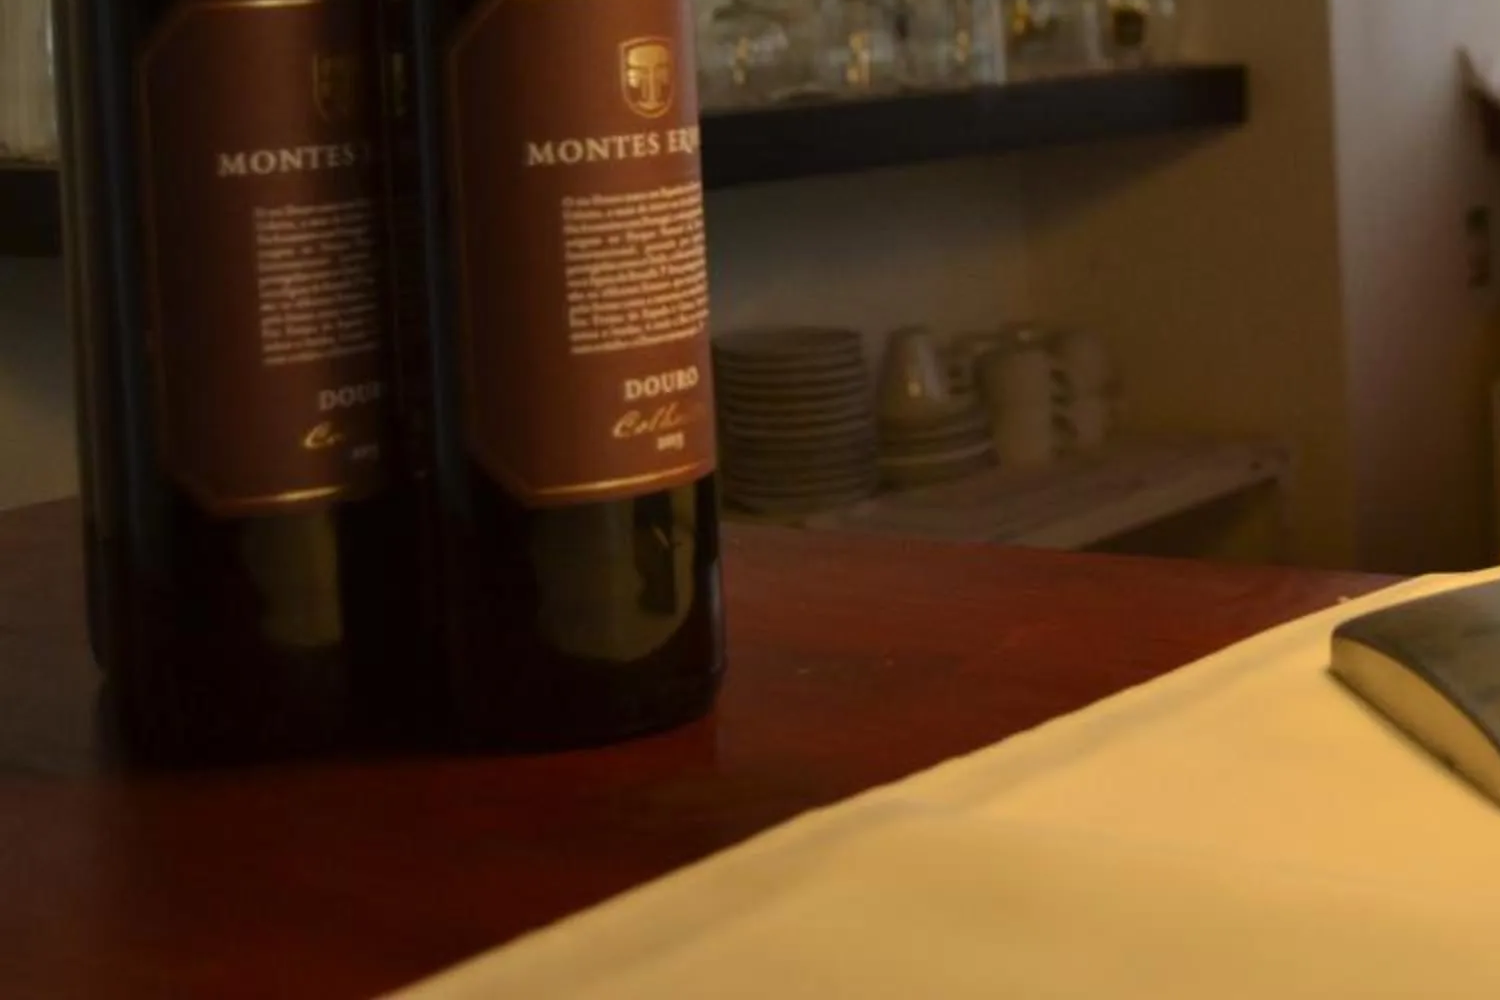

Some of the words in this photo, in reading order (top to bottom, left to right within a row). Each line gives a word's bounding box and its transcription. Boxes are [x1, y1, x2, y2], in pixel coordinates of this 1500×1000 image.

[215, 142, 355, 178] MONTES
[527, 130, 660, 167] MONTES
[624, 365, 699, 401] DOURO
